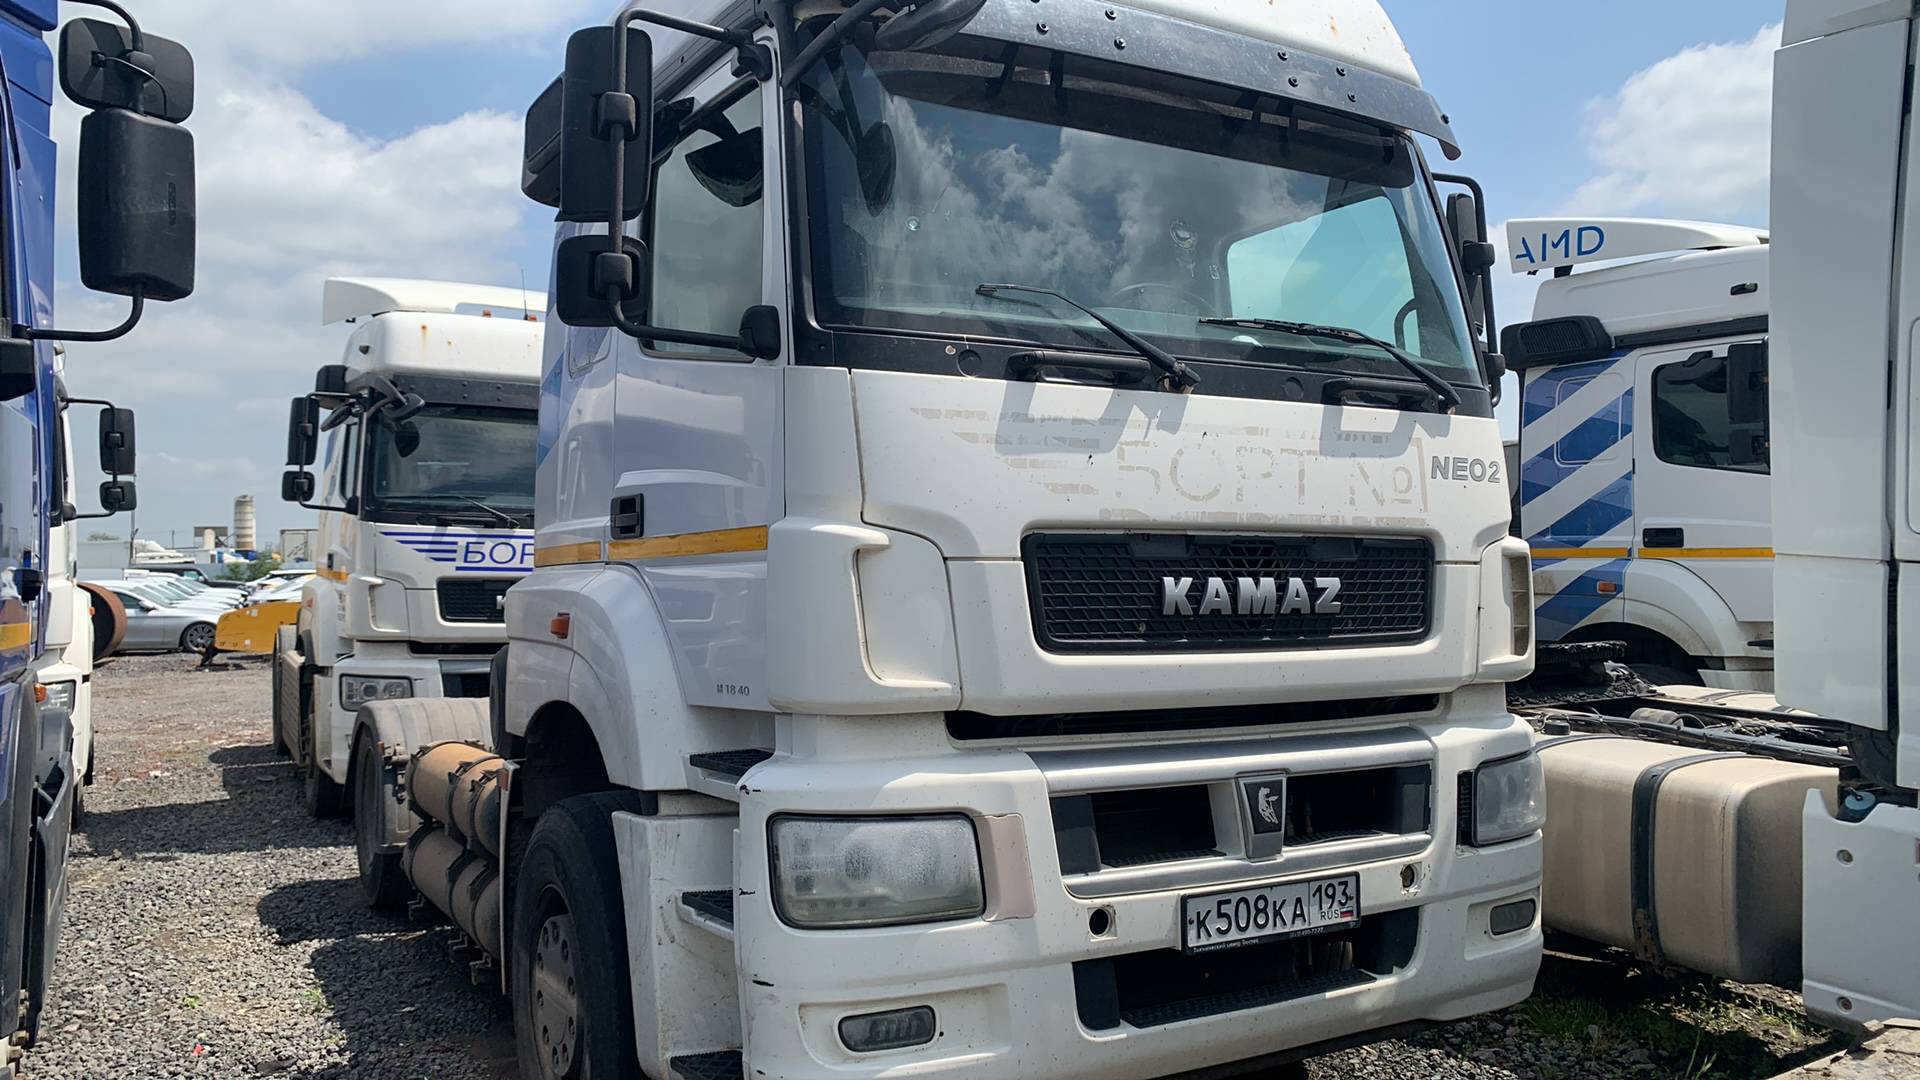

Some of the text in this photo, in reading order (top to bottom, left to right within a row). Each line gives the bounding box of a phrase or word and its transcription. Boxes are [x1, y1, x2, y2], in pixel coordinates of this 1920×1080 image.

[1516, 226, 1605, 264] AMD
[1431, 456, 1501, 483] NEO2
[1162, 576, 1342, 616] KAMAZ
[1312, 881, 1349, 910] 193
[1320, 909, 1340, 921] RUS
